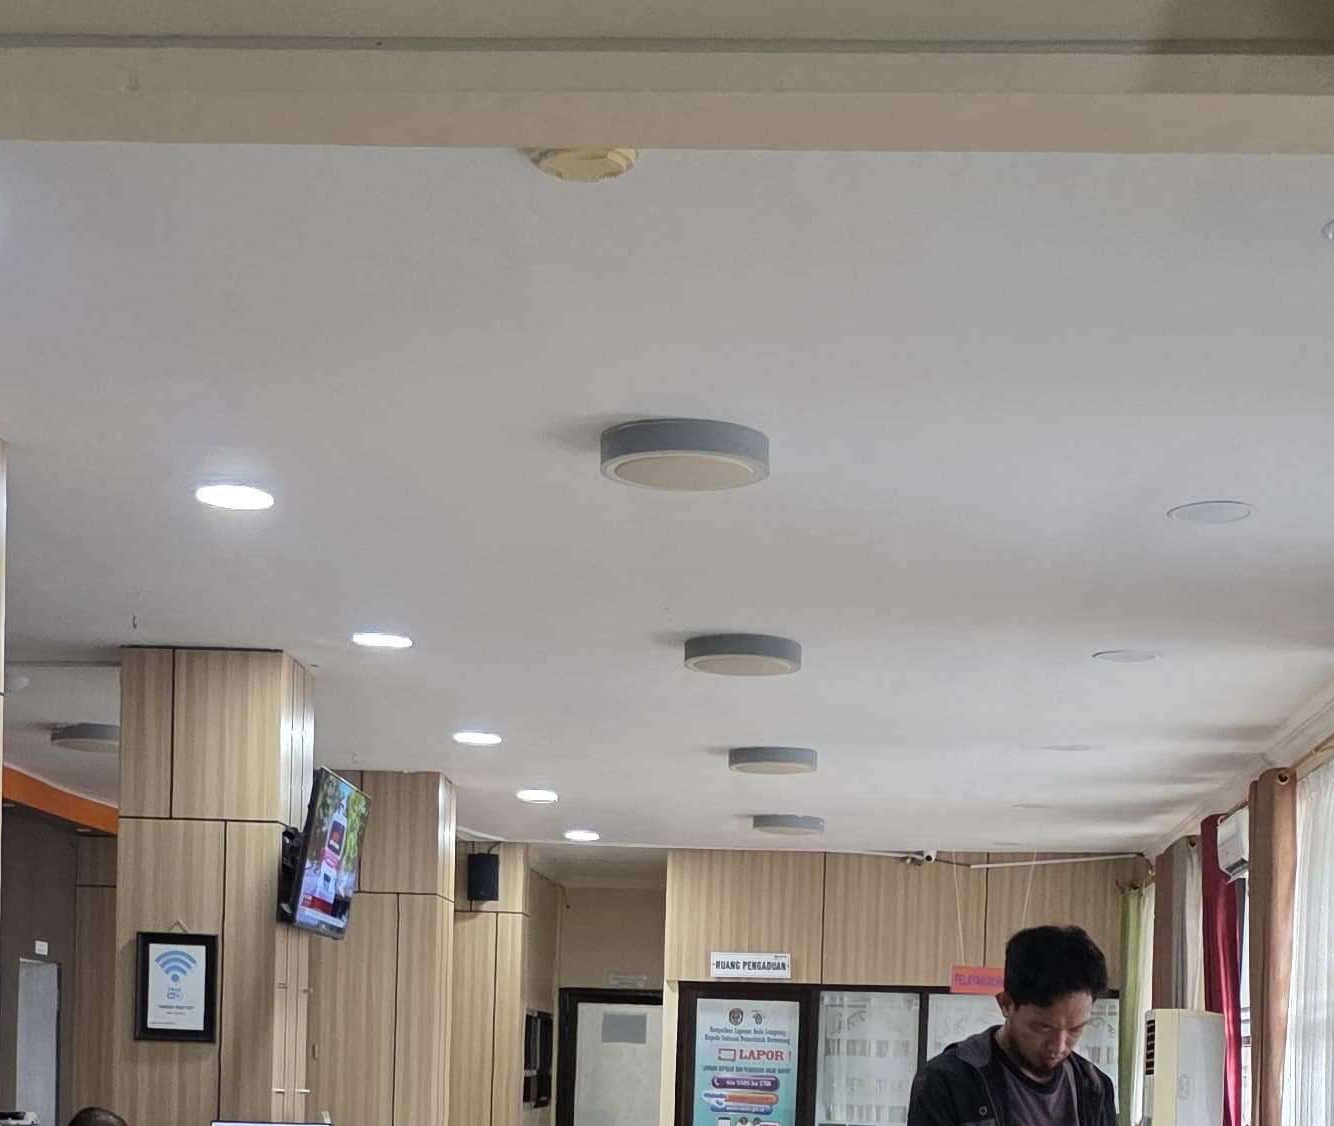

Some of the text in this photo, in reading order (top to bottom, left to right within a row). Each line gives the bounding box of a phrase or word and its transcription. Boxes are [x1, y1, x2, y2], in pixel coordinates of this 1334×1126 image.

[715, 960, 787, 971] RUANG PENGADUAN
[738, 1048, 785, 1061] LAPOR
